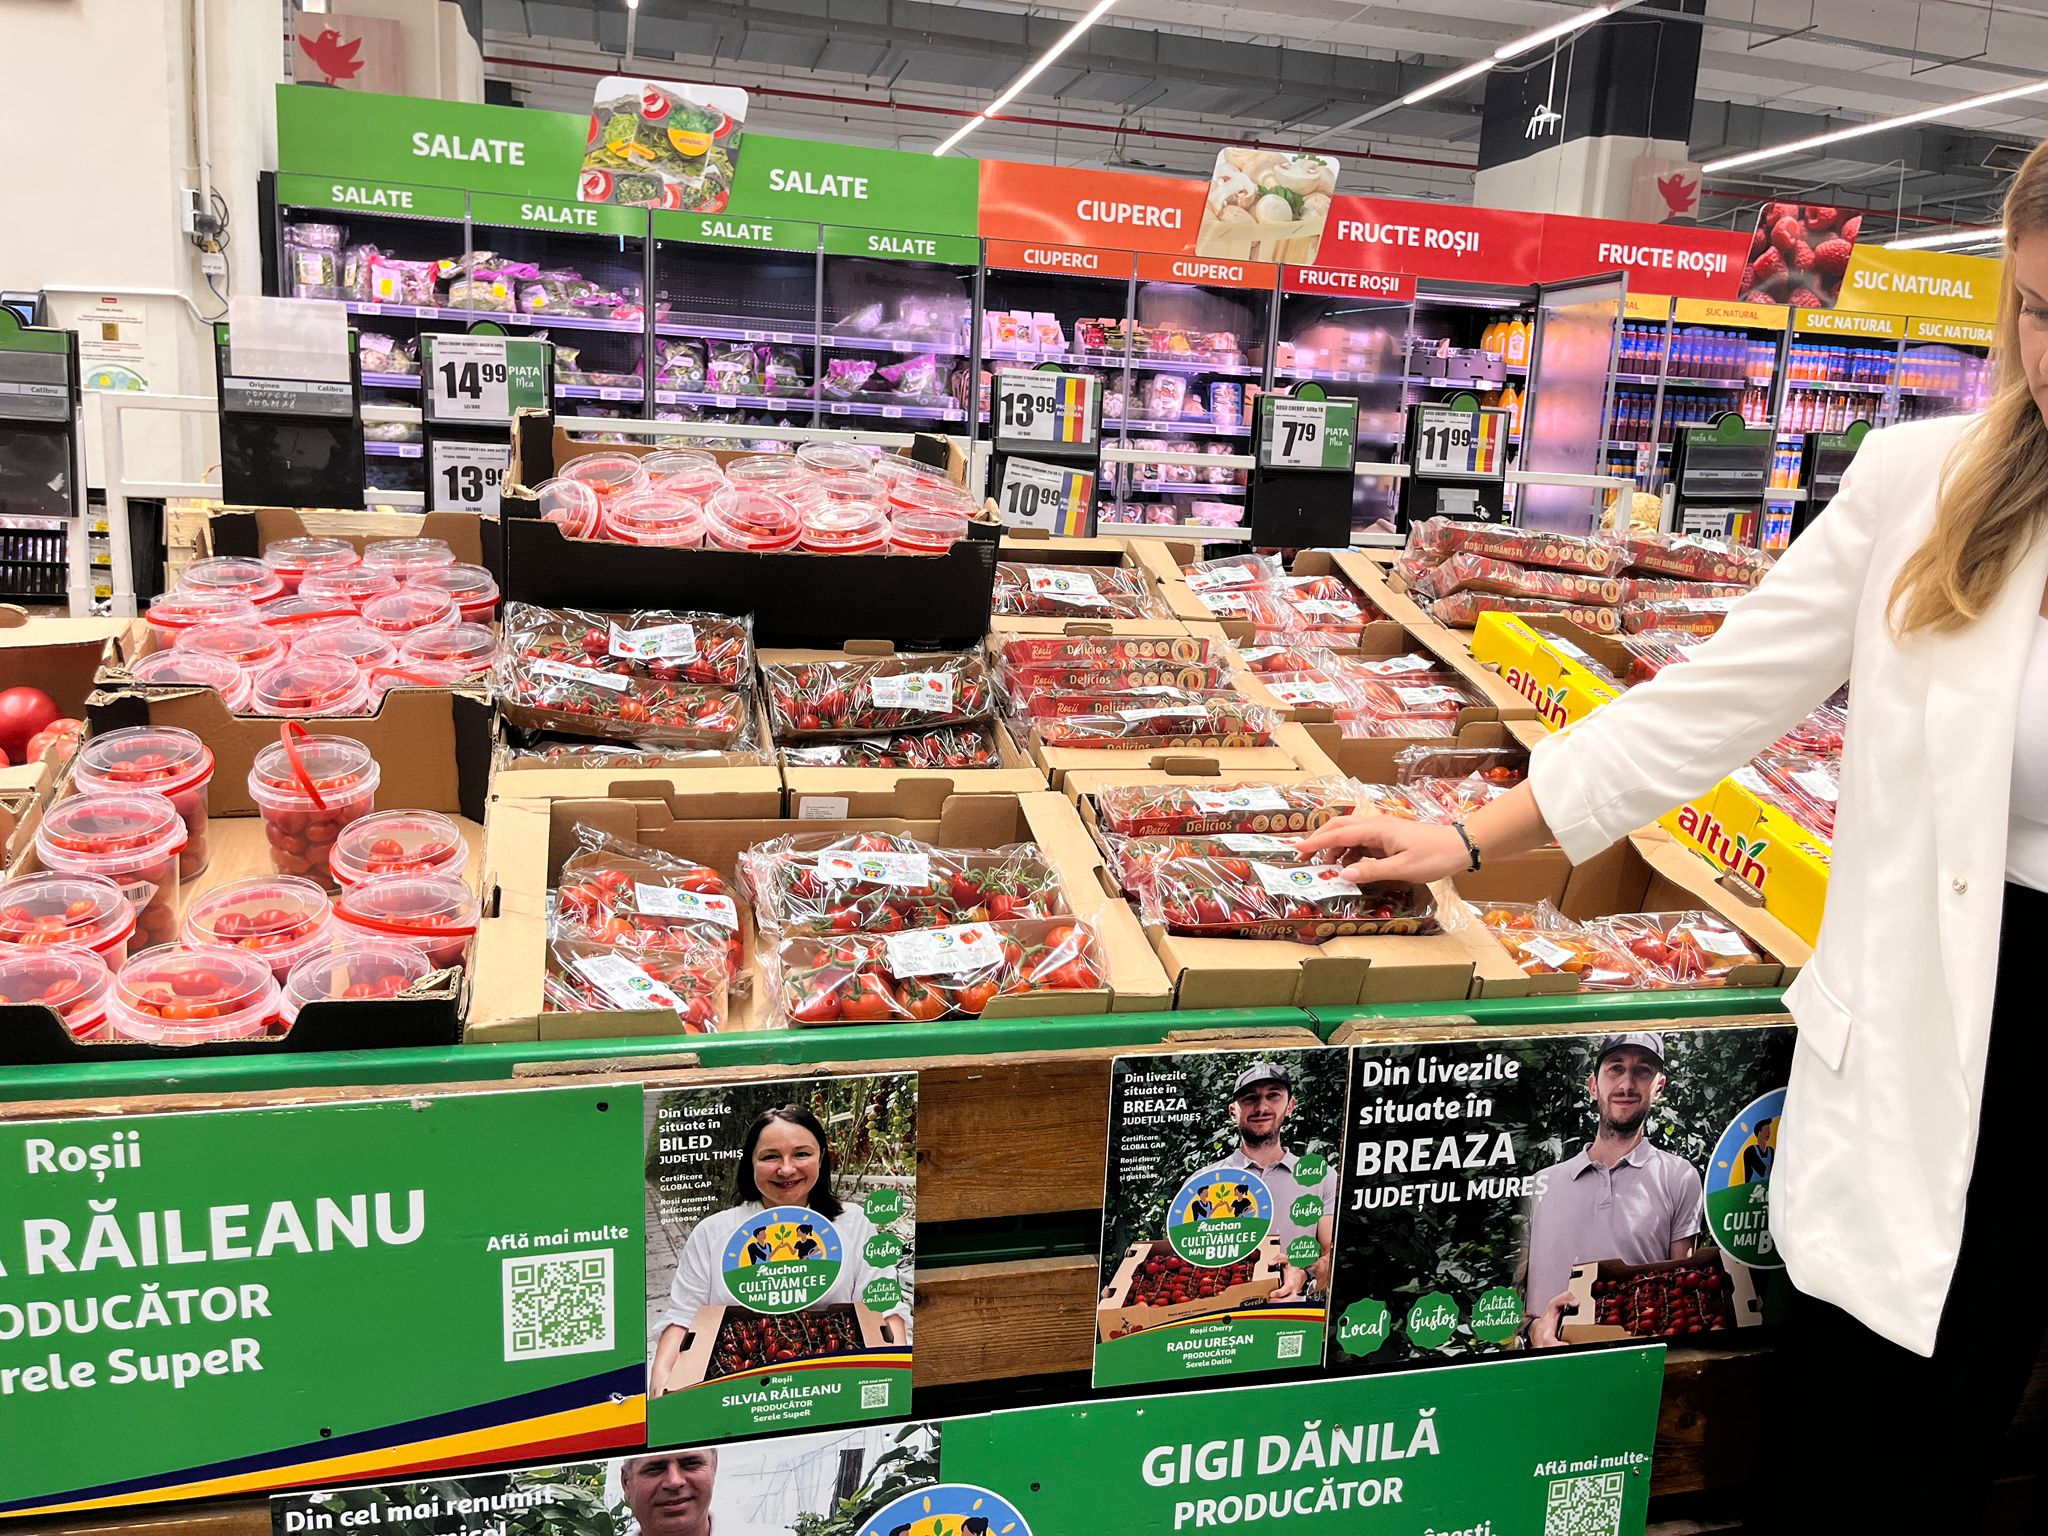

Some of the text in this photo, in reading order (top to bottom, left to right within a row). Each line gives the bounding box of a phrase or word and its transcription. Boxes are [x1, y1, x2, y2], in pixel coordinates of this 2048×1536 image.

[412, 132, 525, 166] SALATE
[769, 168, 869, 200] SALATE
[331, 185, 413, 209] SALATE
[521, 203, 598, 227] SALATE
[1076, 199, 1182, 229] CIUPERCI
[701, 220, 773, 242] SALATE
[1337, 220, 1480, 258] FRUCTE ROȘII
[868, 235, 936, 256] SALATE
[1023, 248, 1098, 270] CIUPERCI
[1598, 243, 1728, 280] FRUCTE ROȘII
[1172, 261, 1244, 282] CIUPERCI
[1299, 269, 1400, 296] FRUCTE ROȘII
[1853, 269, 1974, 300] SUC NATURAL
[1705, 307, 1759, 321] SUC NATURAL
[1806, 313, 1893, 334] SUC NATURAL
[1918, 322, 1996, 343] SUC NATURA
[30, 386, 59, 395] Calibru
[249, 381, 280, 390] Originea
[317, 384, 344, 393] Calibru
[1067, 644, 1107, 656] Delicios
[1069, 673, 1112, 686] Delicios
[1506, 668, 1568, 729] altun
[1185, 818, 1233, 833] Delicios
[1678, 806, 1767, 890] altun
[1239, 922, 1293, 937] Delicios
[1125, 1070, 1187, 1084] Din livezile
[1363, 1053, 1520, 1088] Din livezile
[1124, 1084, 1177, 1097] situate în
[659, 1104, 732, 1119] Din livezile
[1123, 1097, 1188, 1114] BREAZA
[1359, 1092, 1492, 1126] situate în
[659, 1119, 721, 1133] situate în
[1122, 1112, 1201, 1127] JUDEȚUL MUREȘ
[659, 1135, 713, 1152] BILED
[1121, 1134, 1159, 1143] Certificare
[1121, 1143, 1150, 1151] GLOBAL
[24, 1130, 142, 1183] Roșii
[659, 1148, 744, 1165] JUDEȚUL TIMIȘ
[1138, 1155, 1161, 1164] cherry
[1355, 1132, 1516, 1177] BREAZA
[1120, 1164, 1155, 1173] suculente
[1295, 1159, 1326, 1177] Local
[660, 1173, 703, 1183] Certificare
[660, 1180, 712, 1192] GLOBAL GAP
[1351, 1173, 1549, 1213] JUDEȚUL MUREȘ
[660, 1205, 702, 1215] delicioase
[866, 1195, 901, 1215] Local
[1291, 1201, 1325, 1218] Gustos
[23, 1188, 426, 1276] RĂILEANU
[1197, 1221, 1242, 1233] Auchan
[486, 1225, 629, 1252] Află mai multe
[1236, 1231, 1257, 1243] CE E
[1733, 1232, 1757, 1247] MAI
[865, 1242, 902, 1259] Gustos
[1188, 1243, 1240, 1260] MAI BUN
[1290, 1241, 1316, 1251] Calitate
[756, 1264, 808, 1277] Auchan
[802, 1274, 827, 1288] CE E
[867, 1284, 896, 1295] Calitate
[748, 1288, 808, 1307] MAI BUN
[1479, 1295, 1516, 1313] Calitate
[1340, 1309, 1388, 1340] Local
[1410, 1304, 1457, 1334] Gustos
[1189, 1324, 1234, 1336] Roșii Cherry
[1166, 1334, 1255, 1353] RADU UREȘAN
[1182, 1347, 1237, 1361] PRODUCĂTOR
[108, 1337, 264, 1389] SupeR
[1185, 1360, 1211, 1369] Serele
[771, 1375, 793, 1385] Roșii
[722, 1382, 842, 1408] SILVIA RĂILEANU
[751, 1399, 813, 1414] PRODUCĂTOR
[753, 1409, 811, 1423] Serele SupeR
[1141, 1407, 1440, 1488] GIGI DĂNILĂ
[1533, 1451, 1644, 1478] Află mai multe
[286, 1488, 555, 1533] Din cel mai renumit
[1173, 1476, 1404, 1531] PRODUCĂTOR
